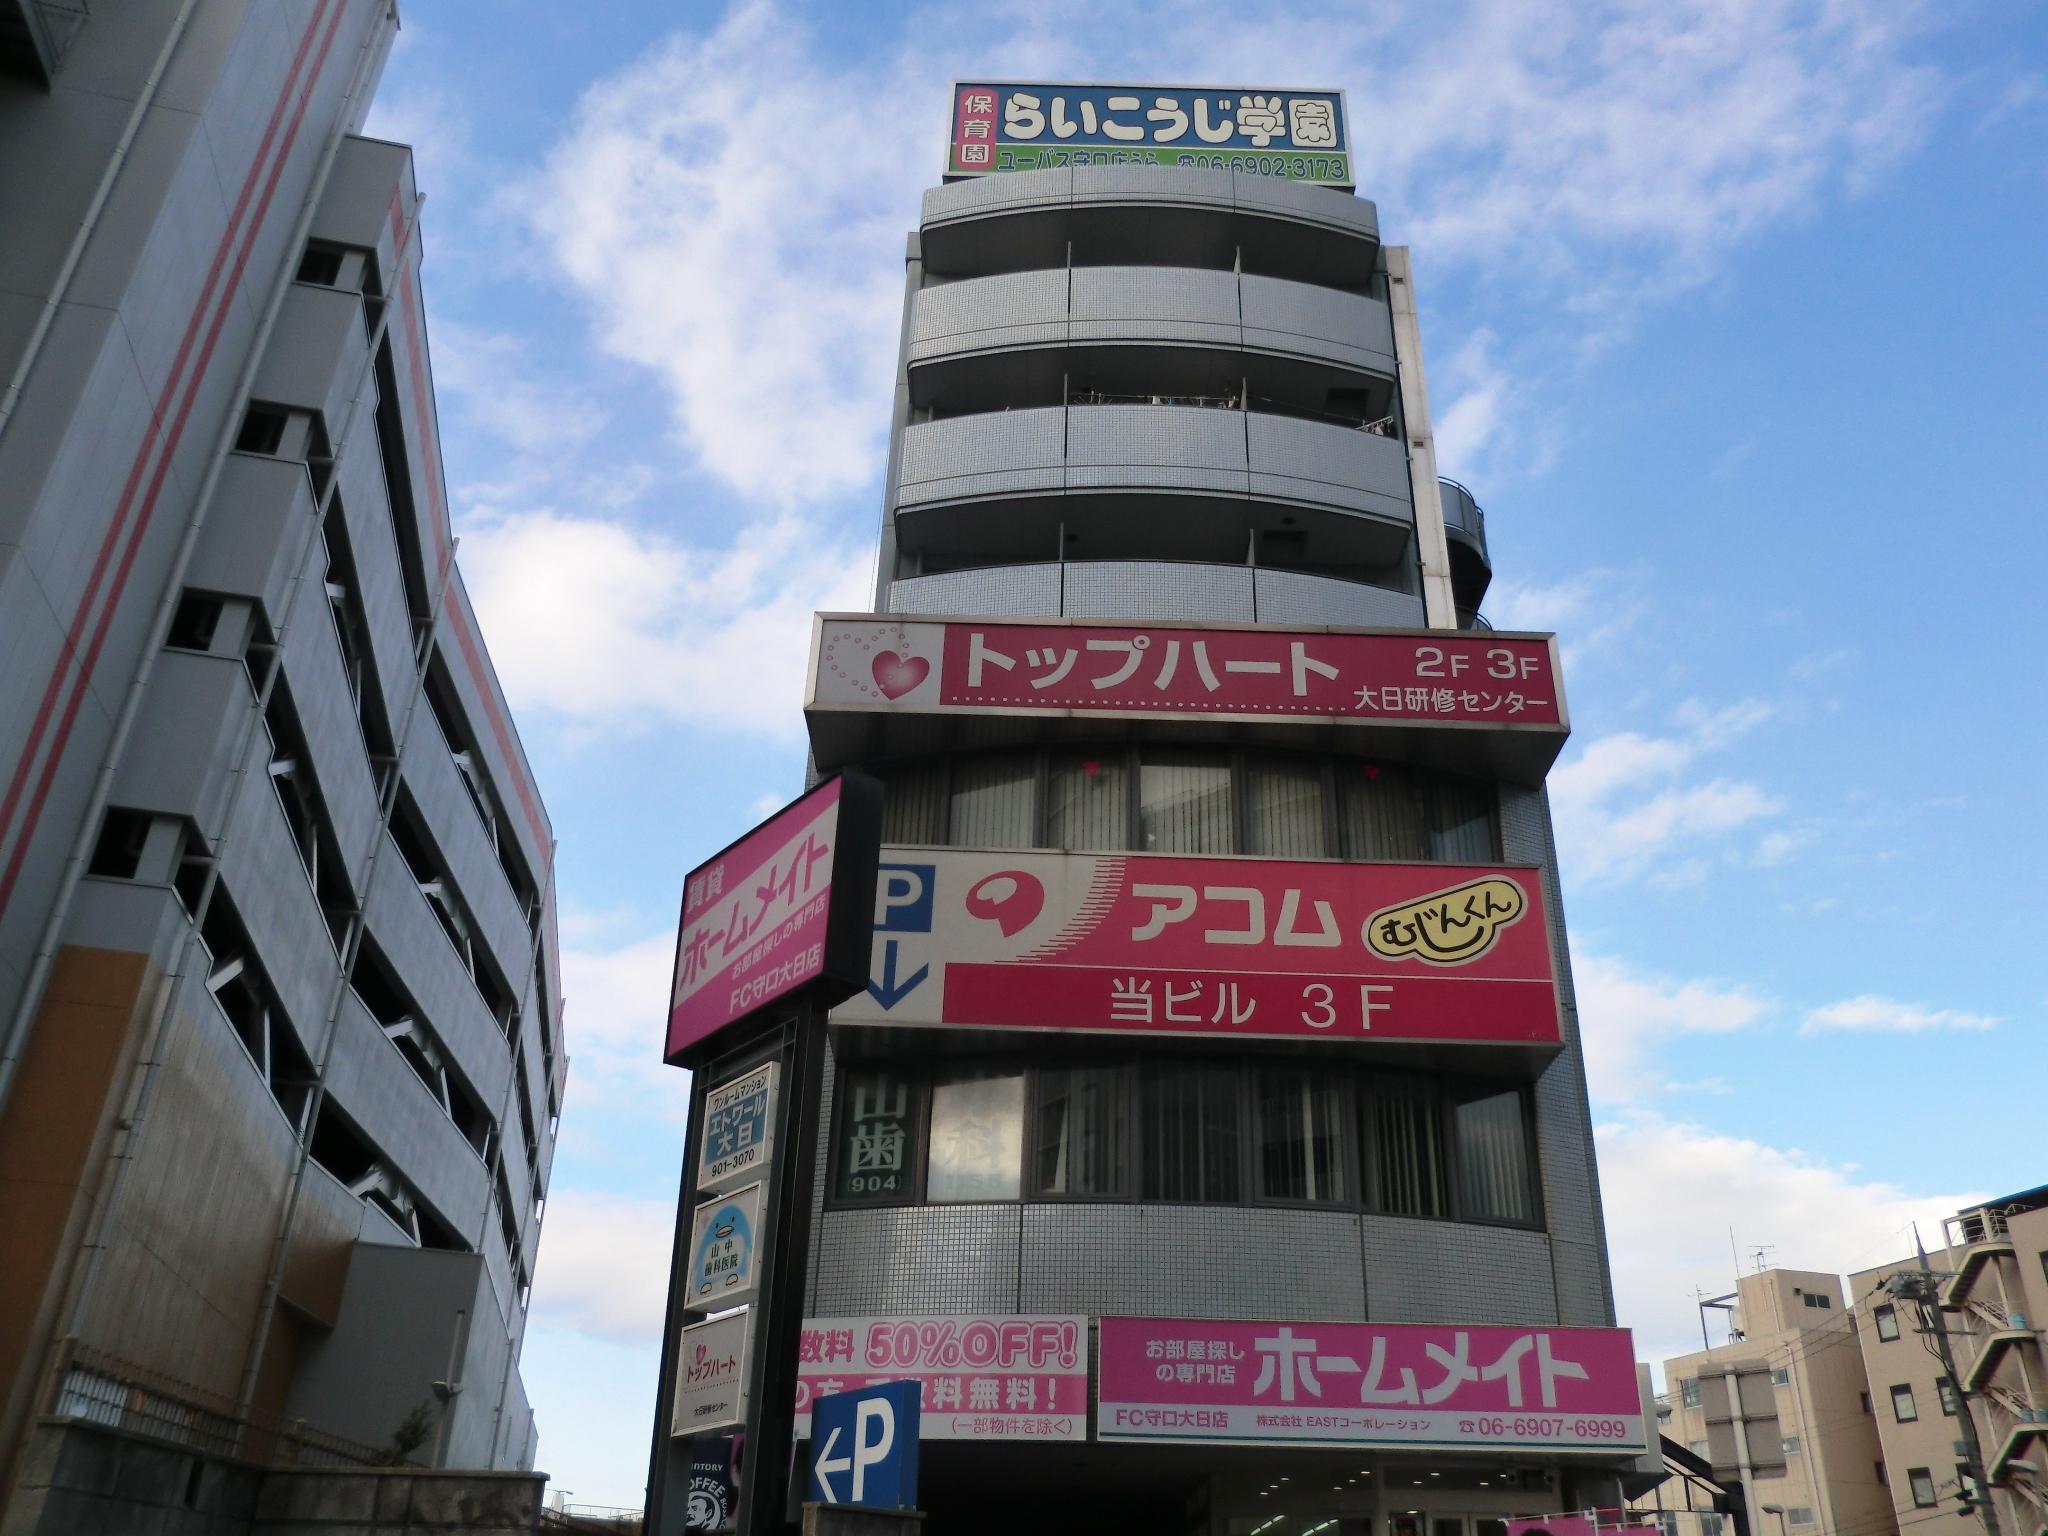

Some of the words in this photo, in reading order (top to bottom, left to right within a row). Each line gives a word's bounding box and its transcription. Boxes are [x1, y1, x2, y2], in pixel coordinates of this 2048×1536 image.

[961, 94, 993, 163] 保育園
[1003, 92, 1338, 148] らいこうじ学園
[1197, 155, 1344, 179] 06-6902-3173
[967, 632, 1340, 697] トップハート
[1415, 646, 1469, 678] 2F
[1486, 648, 1539, 680] 3F
[1353, 685, 1548, 714] 大日研修センター
[678, 831, 830, 991] ホームメイト
[1131, 883, 1343, 947] アコム
[1381, 880, 1513, 953] むじんくん
[732, 893, 826, 980] お部屋探しの専門店
[728, 942, 822, 1015] FC守口大日店
[1109, 976, 1257, 1026] 当ビル
[713, 1075, 767, 1112] ワンルームマンション
[709, 1094, 766, 1137] エトワール
[716, 1120, 754, 1156] 大日
[711, 1149, 755, 1178] 901-3070
[704, 1252, 739, 1277] 歯科医院
[1145, 1338, 1247, 1361] お部屋探し
[1252, 1326, 1591, 1408] ホームメイト
[687, 1354, 736, 1384] トップハート
[1155, 1363, 1237, 1386] の専門店
[951, 1416, 1074, 1437] (一部物件を除く)
[1115, 1409, 1230, 1429] FC守口大日店
[1477, 1417, 1627, 1438] 06-6907-6999
[852, 1397, 896, 1502] P
